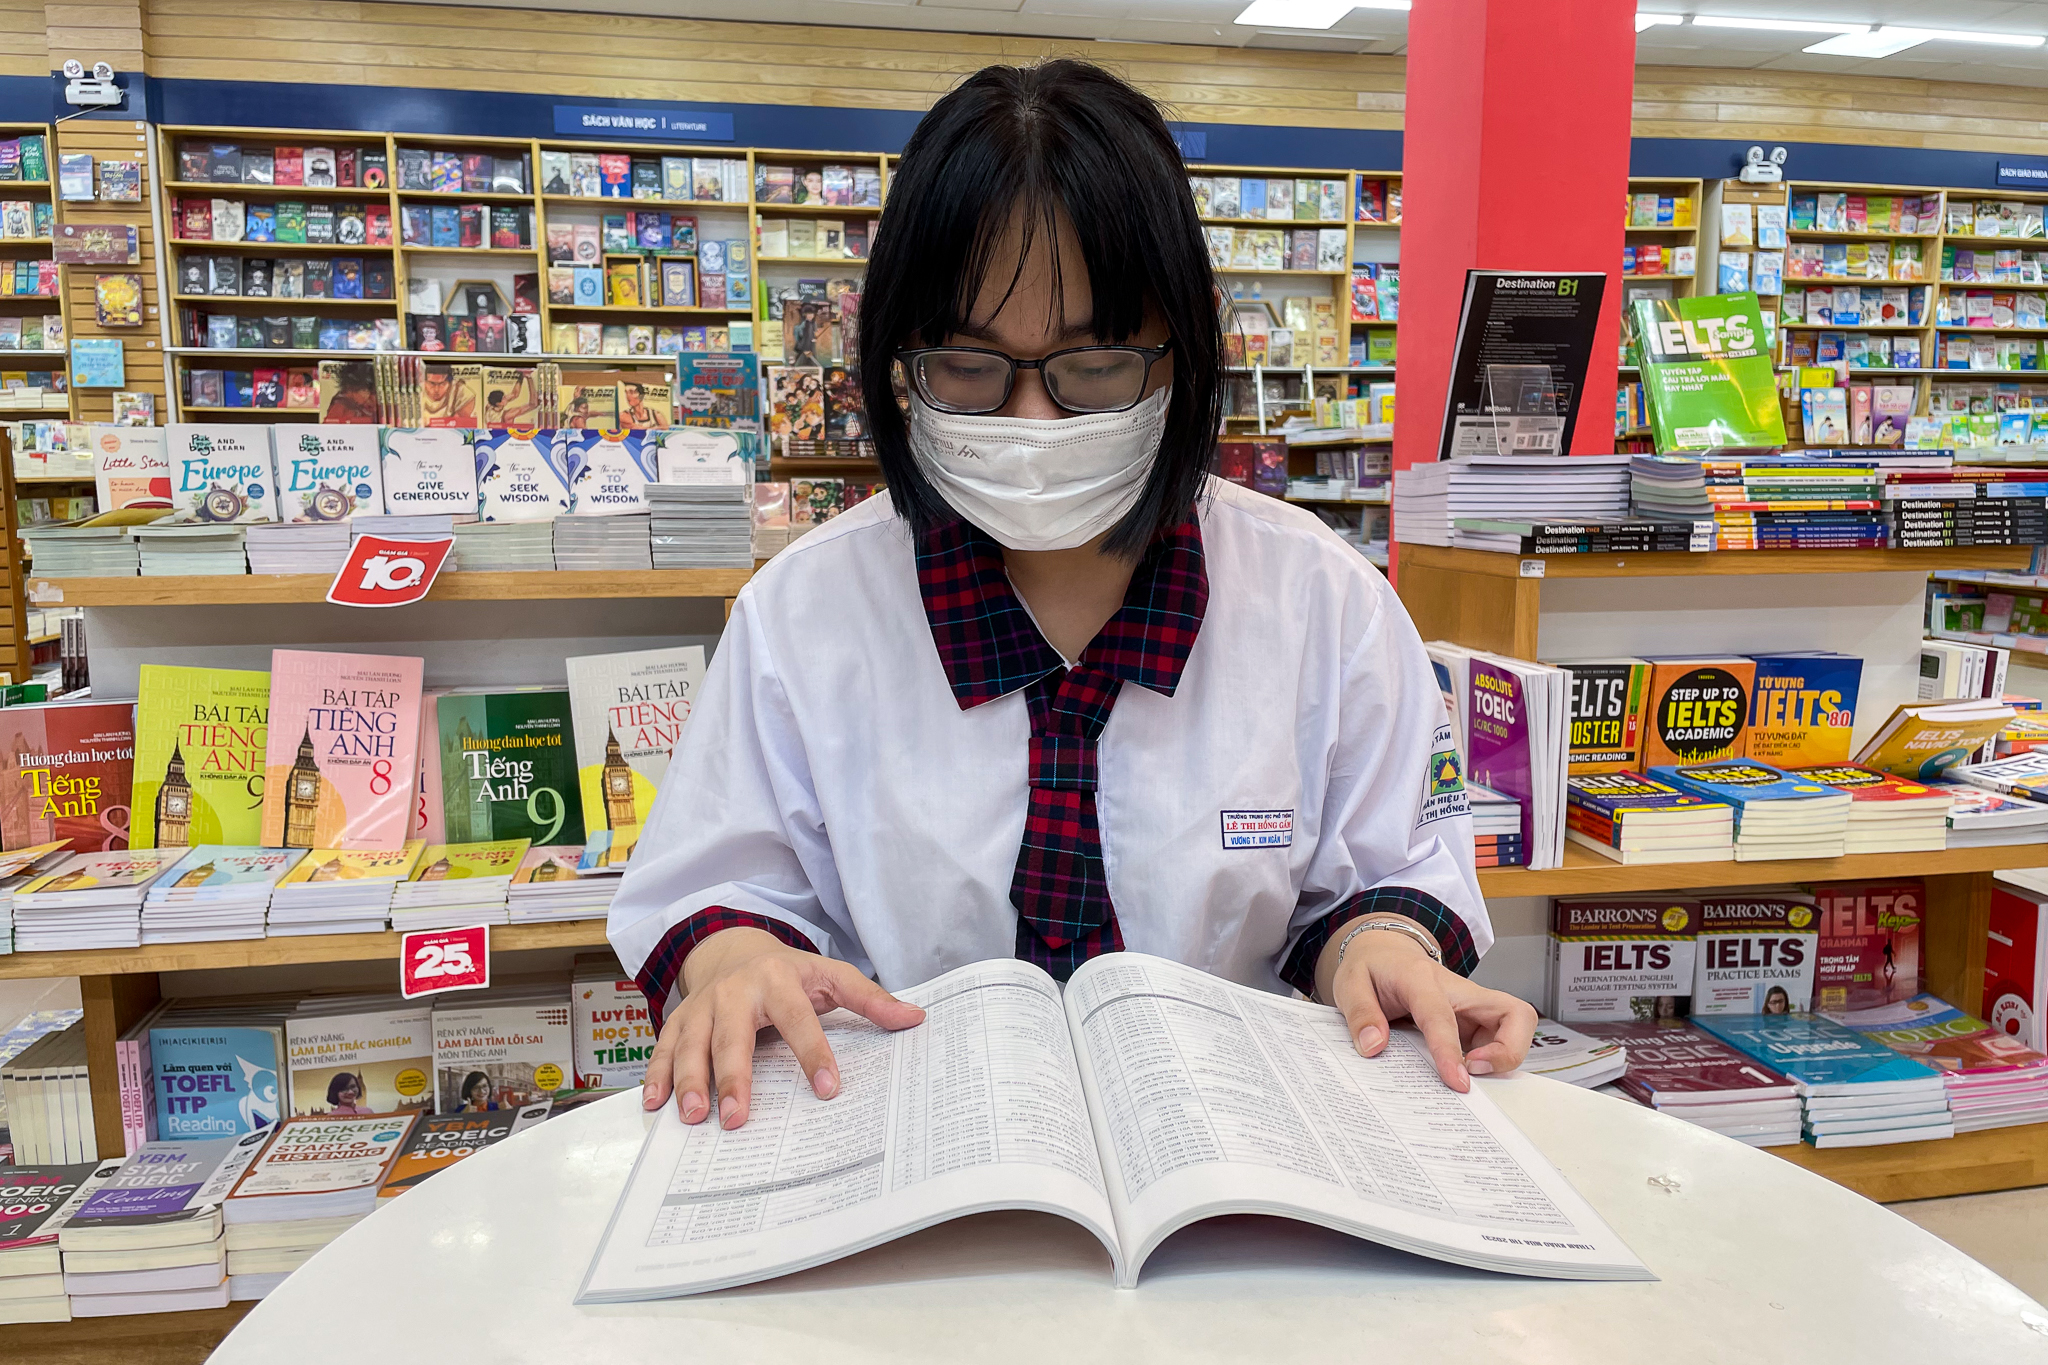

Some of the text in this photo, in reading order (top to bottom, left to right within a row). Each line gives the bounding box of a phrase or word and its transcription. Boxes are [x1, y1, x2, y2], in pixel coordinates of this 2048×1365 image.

[582, 114, 611, 127] SÁCH
[611, 115, 633, 128] VĂN
[635, 117, 657, 130] HỌC
[1496, 278, 1579, 297] Destination B1
[1645, 314, 1756, 356] IELTS
[1713, 327, 1754, 341] Sample
[179, 458, 264, 493] Europe
[289, 458, 372, 493] Europe
[422, 471, 438, 480] TO
[516, 473, 532, 483] TO
[606, 474, 621, 484] TO
[417, 481, 445, 491] GIVE
[509, 483, 539, 493] SEEK
[600, 484, 630, 494] SEEK
[393, 491, 470, 502] GENEROUSLY
[499, 493, 550, 503] WISDOM
[590, 494, 640, 504] WISDOM
[1901, 501, 1941, 510] Destination
[1902, 511, 1942, 520] Destination
[1545, 525, 1586, 535] Destination
[1904, 520, 1944, 529] Destination
[1536, 536, 1578, 545] Destination
[1900, 530, 1941, 539] Destination
[1535, 545, 1577, 554] Destination
[1903, 539, 1944, 548] Destination
[1475, 673, 1514, 698] ABSOLUTE
[1671, 687, 1739, 701] STEP UP TO
[1474, 688, 1516, 726] TOEIC
[1755, 689, 1842, 728] IELTS
[309, 707, 397, 734] TIẾNG
[1667, 700, 1738, 729] IELTS
[1828, 710, 1851, 728] 8.0
[1474, 718, 1508, 740] LC/RC 1000
[1665, 727, 1735, 742] ACADEMIC
[1913, 729, 1965, 741] IELTS
[463, 732, 562, 752] Hướng dẫn học tốt
[1435, 732, 1451, 743] TÂM
[1904, 736, 1986, 750] NAVIGATOR
[329, 733, 395, 758] ANH
[19, 745, 134, 767] Hướng dẫn học tốt
[463, 751, 533, 784] Tiếng
[21, 768, 102, 801] Tiếng
[370, 760, 392, 795] 8
[476, 778, 528, 803] Anh
[1437, 794, 1460, 805] HIỆU
[39, 795, 97, 820] Anh
[526, 787, 565, 846] 9
[1425, 810, 1438, 820] THỊ
[100, 805, 131, 850] 8
[1226, 821, 1238, 830] LÊ
[1240, 823, 1256, 831] THỊ
[1258, 820, 1277, 829] HỒNG
[1570, 908, 1657, 924] BARRON'S
[1703, 904, 1786, 919] BARRON'S
[1820, 894, 1918, 937] IELTS
[1877, 911, 1904, 932] Key
[1820, 938, 1868, 948] GRAMMAR
[414, 942, 476, 979] 25%
[1583, 945, 1671, 971] IELTS
[1706, 938, 1804, 970] IELTS
[1573, 973, 1674, 984] INTERNATIONAL ENGLISH
[1707, 968, 1802, 981] PRACTICE EXAMS
[1568, 982, 1678, 992] LANGUAGE TESTING SYSTEM
[592, 1004, 648, 1025] LUYỆN
[291, 1044, 315, 1057] LÀM
[317, 1043, 336, 1054] BÀI
[368, 1036, 411, 1049] NGHIỆM
[438, 1037, 461, 1049] LÀM
[464, 1036, 483, 1048] BÀI
[485, 1035, 505, 1046] TÌM
[526, 1035, 543, 1044] SAI
[1768, 1040, 1862, 1056] Upgrade
[340, 1053, 357, 1062] ANH
[488, 1048, 507, 1057] ANH
[163, 1062, 233, 1074] Làm quen với
[1739, 1066, 1775, 1084] 1
[161, 1074, 236, 1093] TOEFL
[167, 1096, 207, 1114] ITP
[168, 1115, 236, 1135] Reading
[288, 1121, 404, 1135] HACKERS
[428, 1120, 490, 1132] YBM
[282, 1133, 354, 1143] TOEIC
[421, 1127, 509, 1142] TOEIC
[275, 1142, 347, 1153] START
[414, 1139, 487, 1149] READING
[137, 1153, 187, 1164] YBM
[272, 1149, 382, 1162] LISTENING
[124, 1161, 203, 1176] START
[115, 1174, 185, 1187] TOEIC
[92, 1187, 193, 1206] Reading
[2, 1223, 22, 1237] 1
